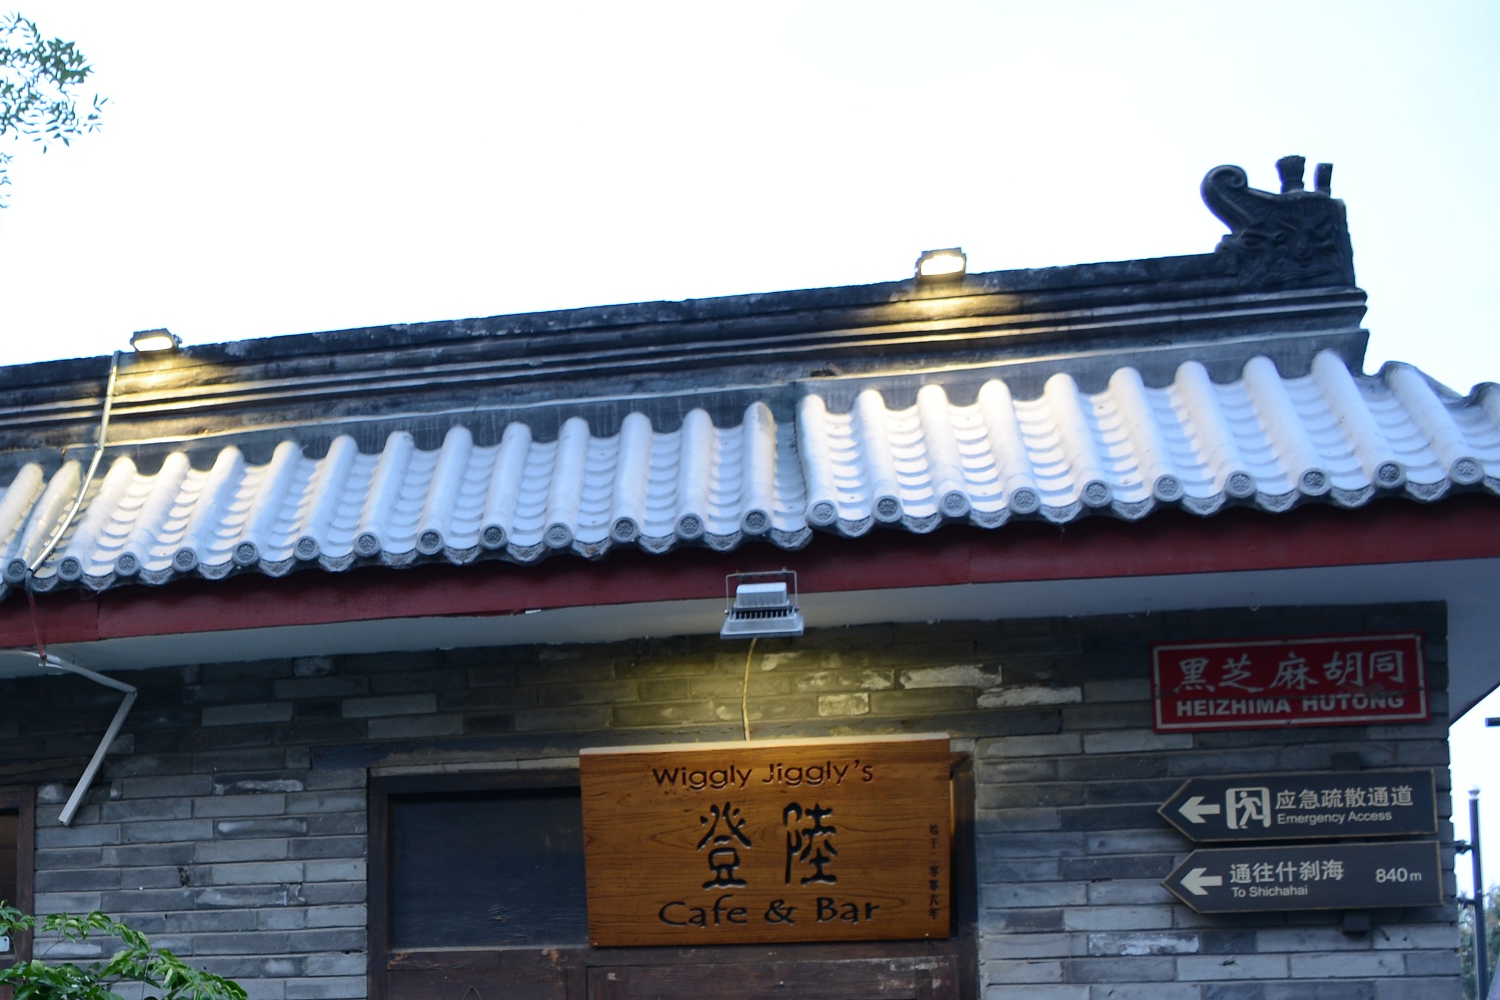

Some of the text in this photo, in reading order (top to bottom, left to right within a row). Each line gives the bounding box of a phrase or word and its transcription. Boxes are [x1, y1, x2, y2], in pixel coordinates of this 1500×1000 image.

[1173, 649, 1405, 694] 黑芝麻胡同
[1176, 692, 1405, 717] HEIZHIMA HUTONG
[652, 759, 874, 791] Wiggly Jiggly's
[1275, 785, 1414, 811] 应急疏散通道
[1277, 809, 1392, 826] Emergency Access
[1229, 859, 1344, 885] 通往什刹海
[1231, 884, 1308, 898] To Shichahai
[658, 893, 880, 928] Cafe & Bar
